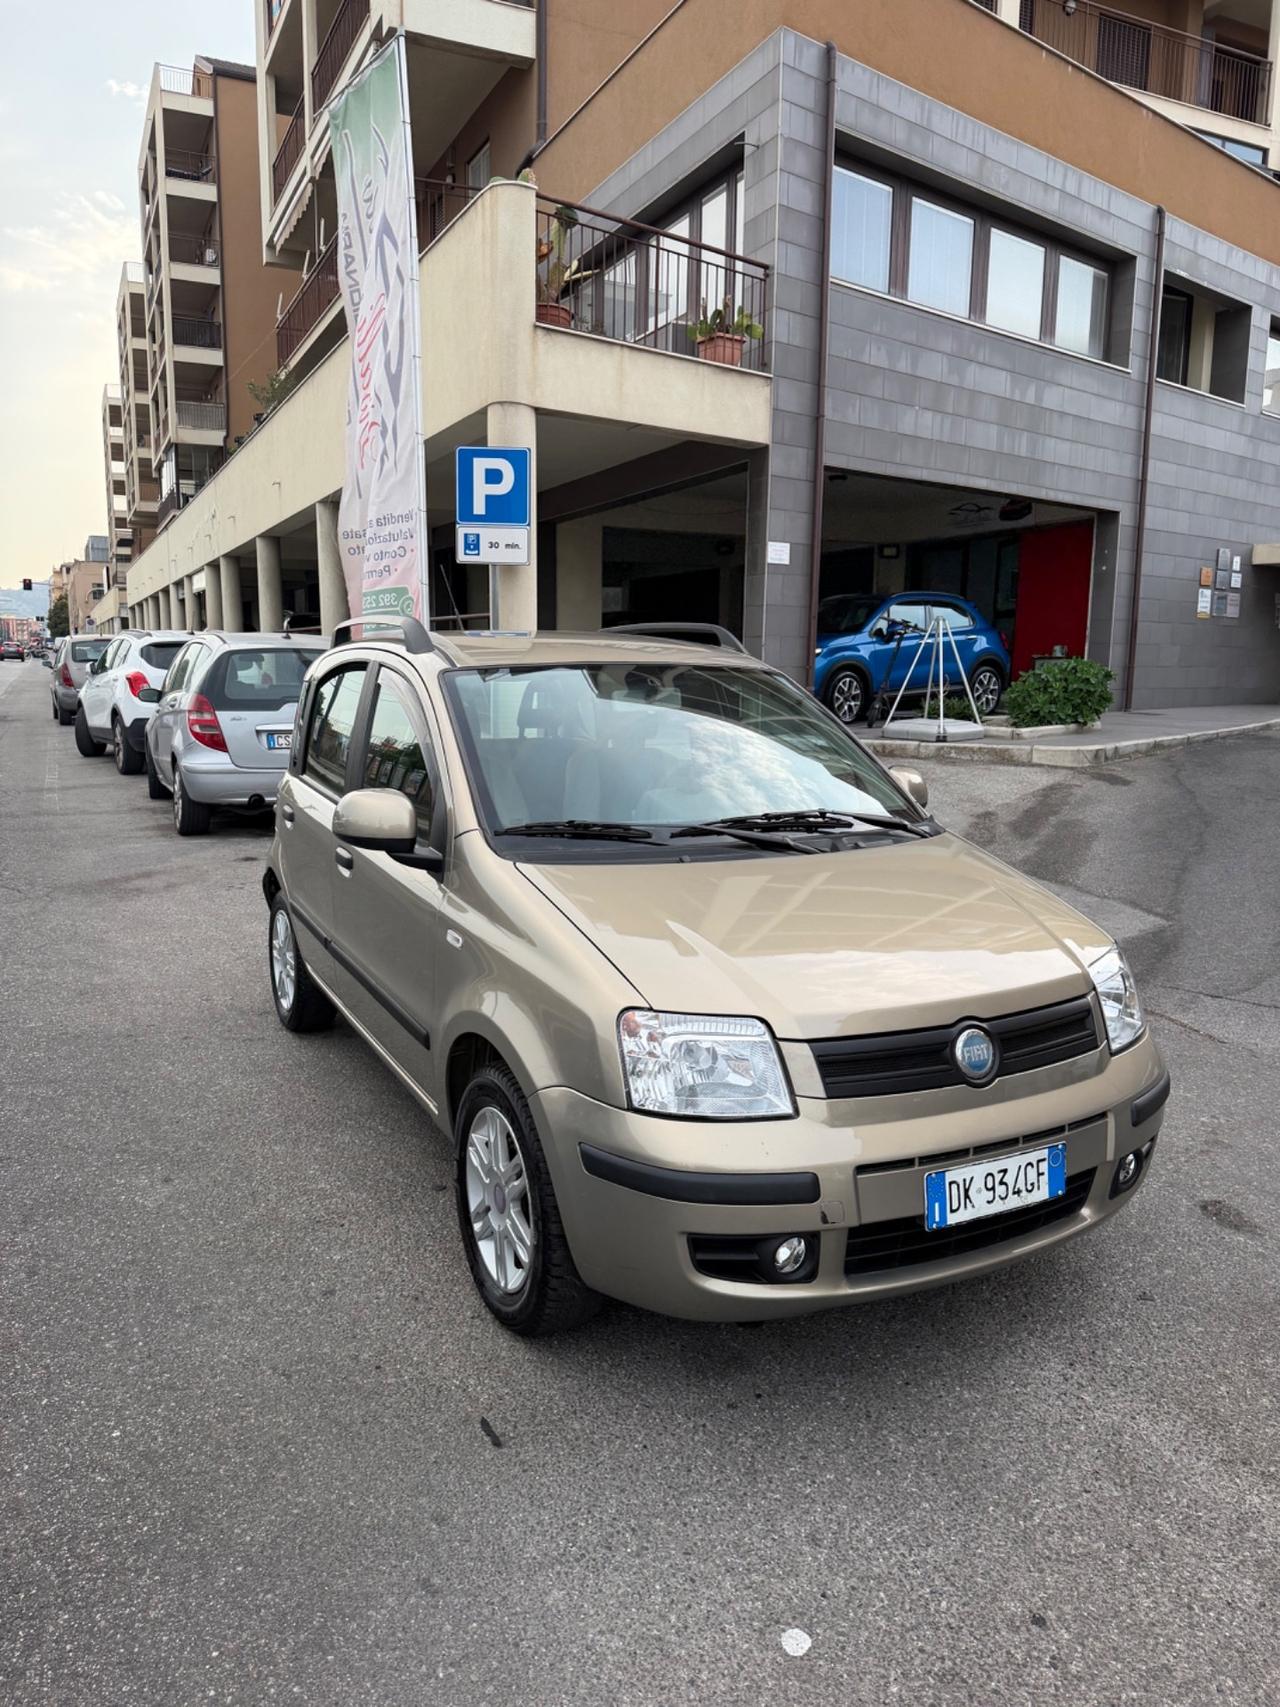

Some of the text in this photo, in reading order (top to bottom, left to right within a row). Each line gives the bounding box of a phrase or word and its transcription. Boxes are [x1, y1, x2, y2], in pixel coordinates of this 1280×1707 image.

[473, 457, 515, 515] P
[488, 541, 500, 549] 30
[948, 1176, 976, 1214] DK
[984, 1157, 1048, 1205] 934GF
